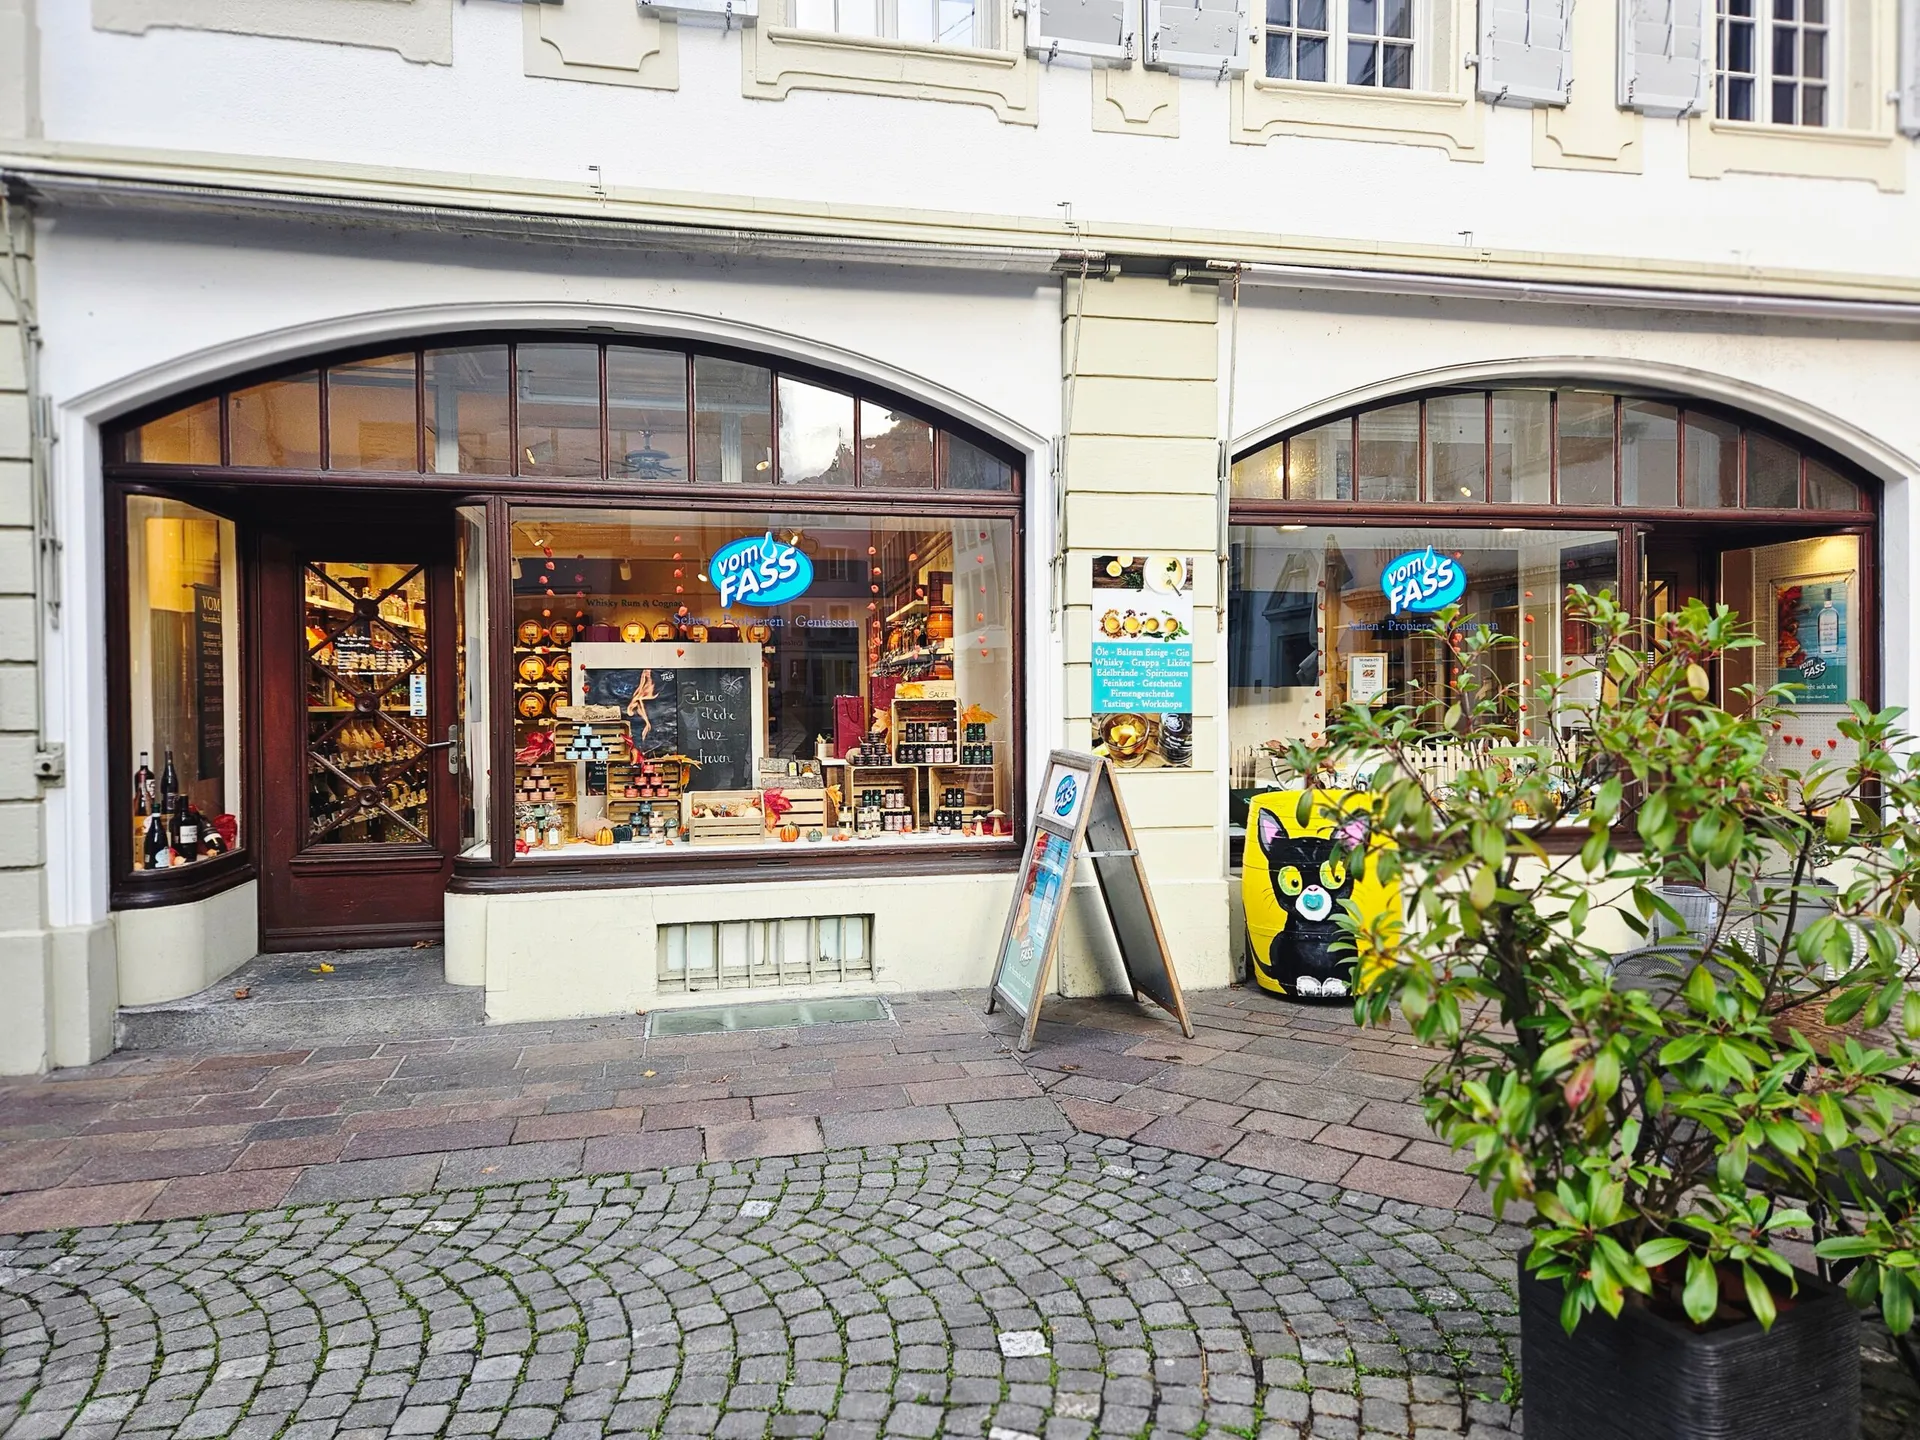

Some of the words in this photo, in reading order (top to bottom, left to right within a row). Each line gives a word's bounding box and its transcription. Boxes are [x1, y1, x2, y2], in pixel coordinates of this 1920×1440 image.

[718, 545, 758, 575] vom
[1388, 557, 1421, 586] vom
[720, 547, 798, 608] FASS
[1390, 558, 1453, 615] FASS
[586, 599, 618, 608] Whisky
[621, 599, 640, 607] Rum
[672, 613, 711, 625] Sehen
[723, 614, 784, 627] Probieren
[795, 615, 858, 627] Geniessen
[1095, 646, 1109, 656] Öle
[1116, 648, 1143, 656] Balsam
[1145, 648, 1168, 658] Essige
[1176, 648, 1190, 657] Gin
[1095, 658, 1123, 668] Whisky
[1131, 658, 1159, 668] Grappa
[1167, 659, 1190, 667] Liköre
[1799, 659, 1814, 670] vom
[1096, 669, 1138, 677] Edelbrände
[1146, 669, 1188, 678] Spirituosen
[1803, 661, 1826, 679] FASS
[1103, 679, 1135, 687] Feinkost
[1142, 679, 1182, 688] Geschenke
[928, 690, 949, 699] SALZE
[1110, 689, 1174, 699] Firmengeschenke
[1102, 699, 1133, 709] Tastings
[1141, 700, 1182, 709] Workshops
